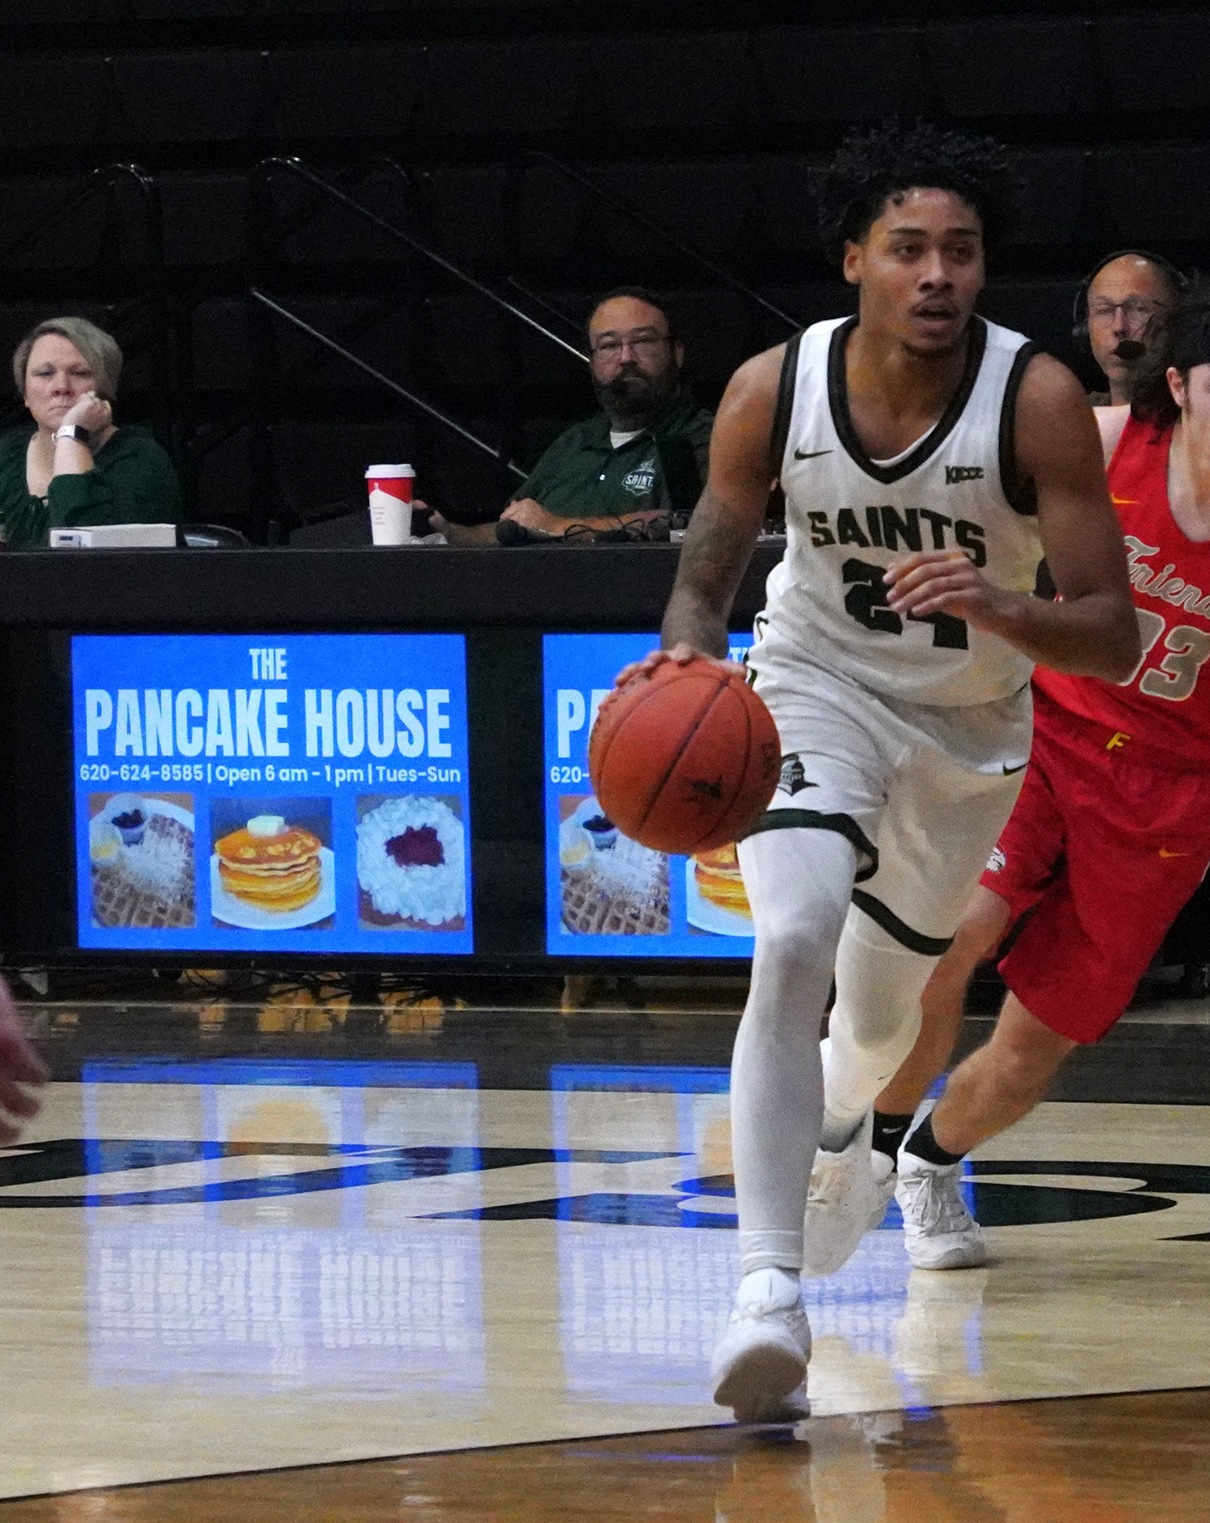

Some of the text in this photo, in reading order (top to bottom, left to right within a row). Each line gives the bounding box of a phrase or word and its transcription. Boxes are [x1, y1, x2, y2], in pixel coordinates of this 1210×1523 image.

[807, 506, 988, 568] SAINTS
[249, 648, 287, 680] THE
[85, 688, 452, 758] PANCAKE HOUSE
[1105, 732, 1131, 750] F
[80, 764, 203, 781] 620-624-8585
[215, 766, 261, 787] Open
[265, 765, 275, 781] 6
[375, 766, 461, 782] Tues-Sun
